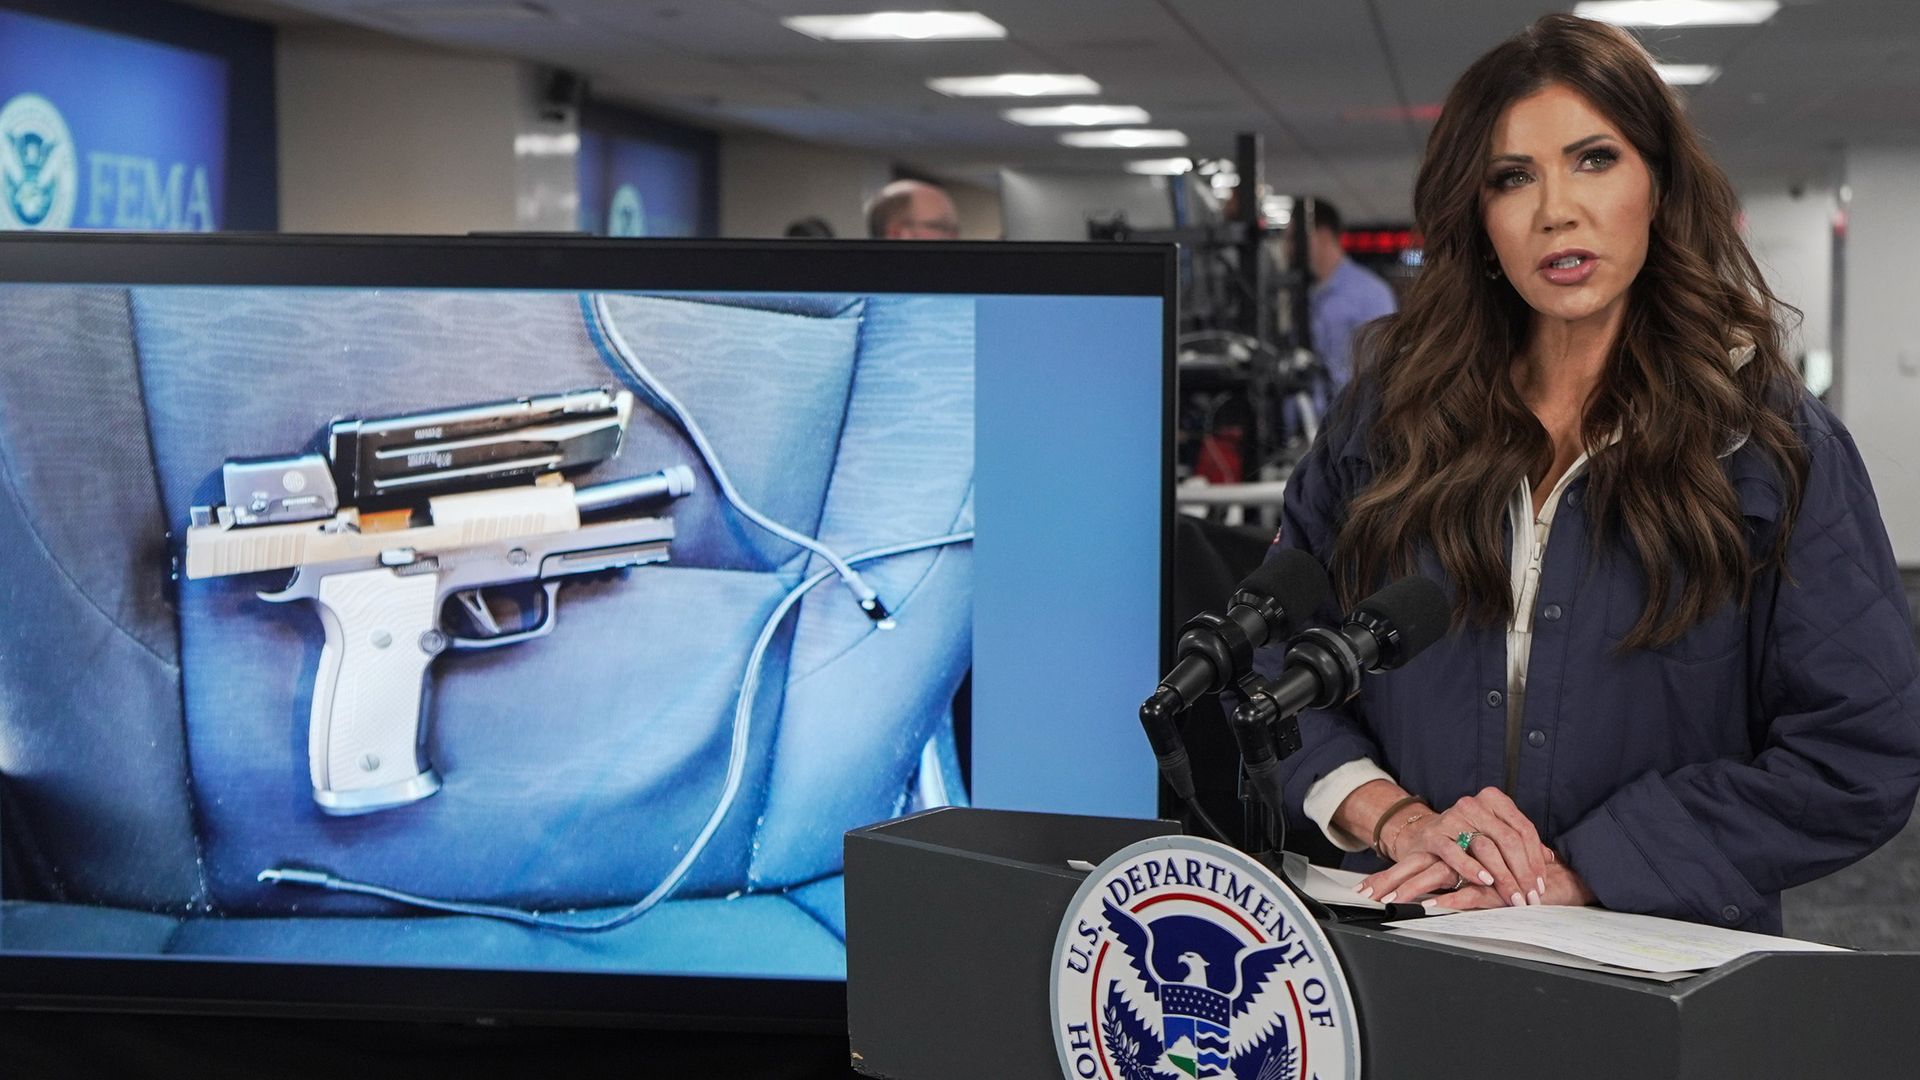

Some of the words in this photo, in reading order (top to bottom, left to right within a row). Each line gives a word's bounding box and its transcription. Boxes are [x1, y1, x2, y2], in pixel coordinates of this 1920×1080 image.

[87, 153, 215, 232] FEMA
[1067, 919, 1103, 974] U.S.
[1107, 857, 1314, 969] DEPARTMENT
[1303, 978, 1335, 1028] OF
[1067, 1022, 1102, 1080] HO
